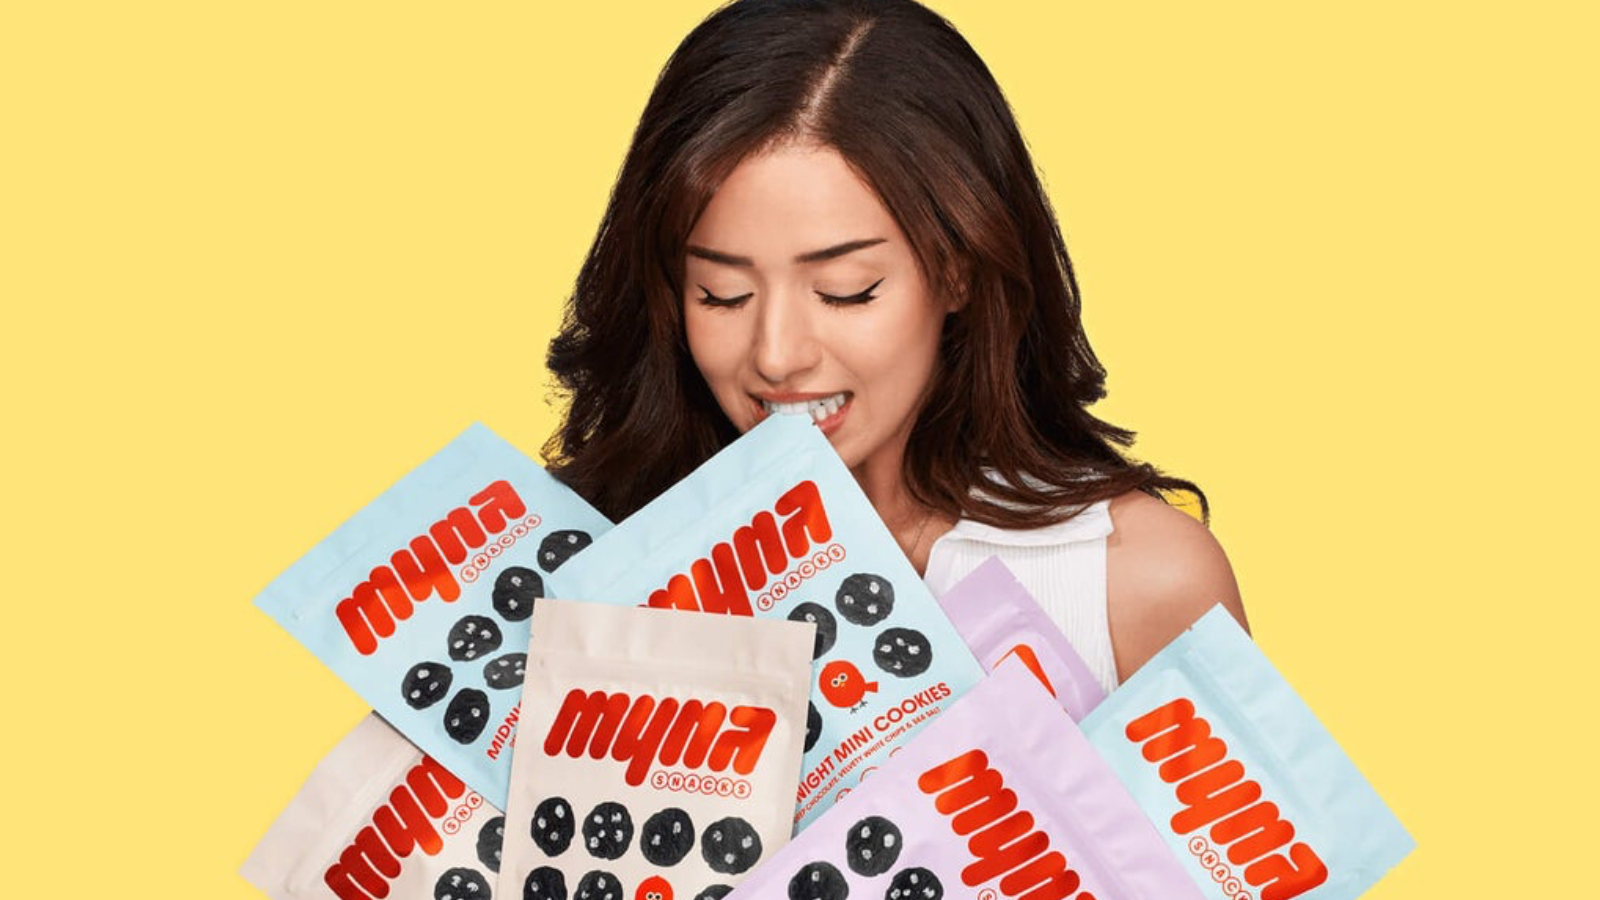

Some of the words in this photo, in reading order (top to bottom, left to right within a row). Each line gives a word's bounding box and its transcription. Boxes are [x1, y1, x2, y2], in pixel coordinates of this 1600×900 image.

[335, 479, 528, 656] myna
[460, 514, 542, 583] SNACKS
[756, 543, 847, 611] SNACKS
[487, 700, 522, 761] MIDNI
[543, 688, 777, 787] myna
[796, 756, 836, 804] NIGHT
[833, 726, 875, 763] MINI
[873, 682, 952, 732] COOKIES
[805, 777, 840, 810] CHOCOLATE
[838, 755, 864, 778] VELVETY
[863, 741, 886, 759] WHITE
[884, 726, 906, 744] CHIPS
[911, 713, 928, 725] SEA
[324, 755, 466, 900] myn
[442, 790, 484, 835] SNA
[651, 770, 752, 800] SNACKS
[918, 748, 1097, 900] myn
[1125, 697, 1329, 900] myna
